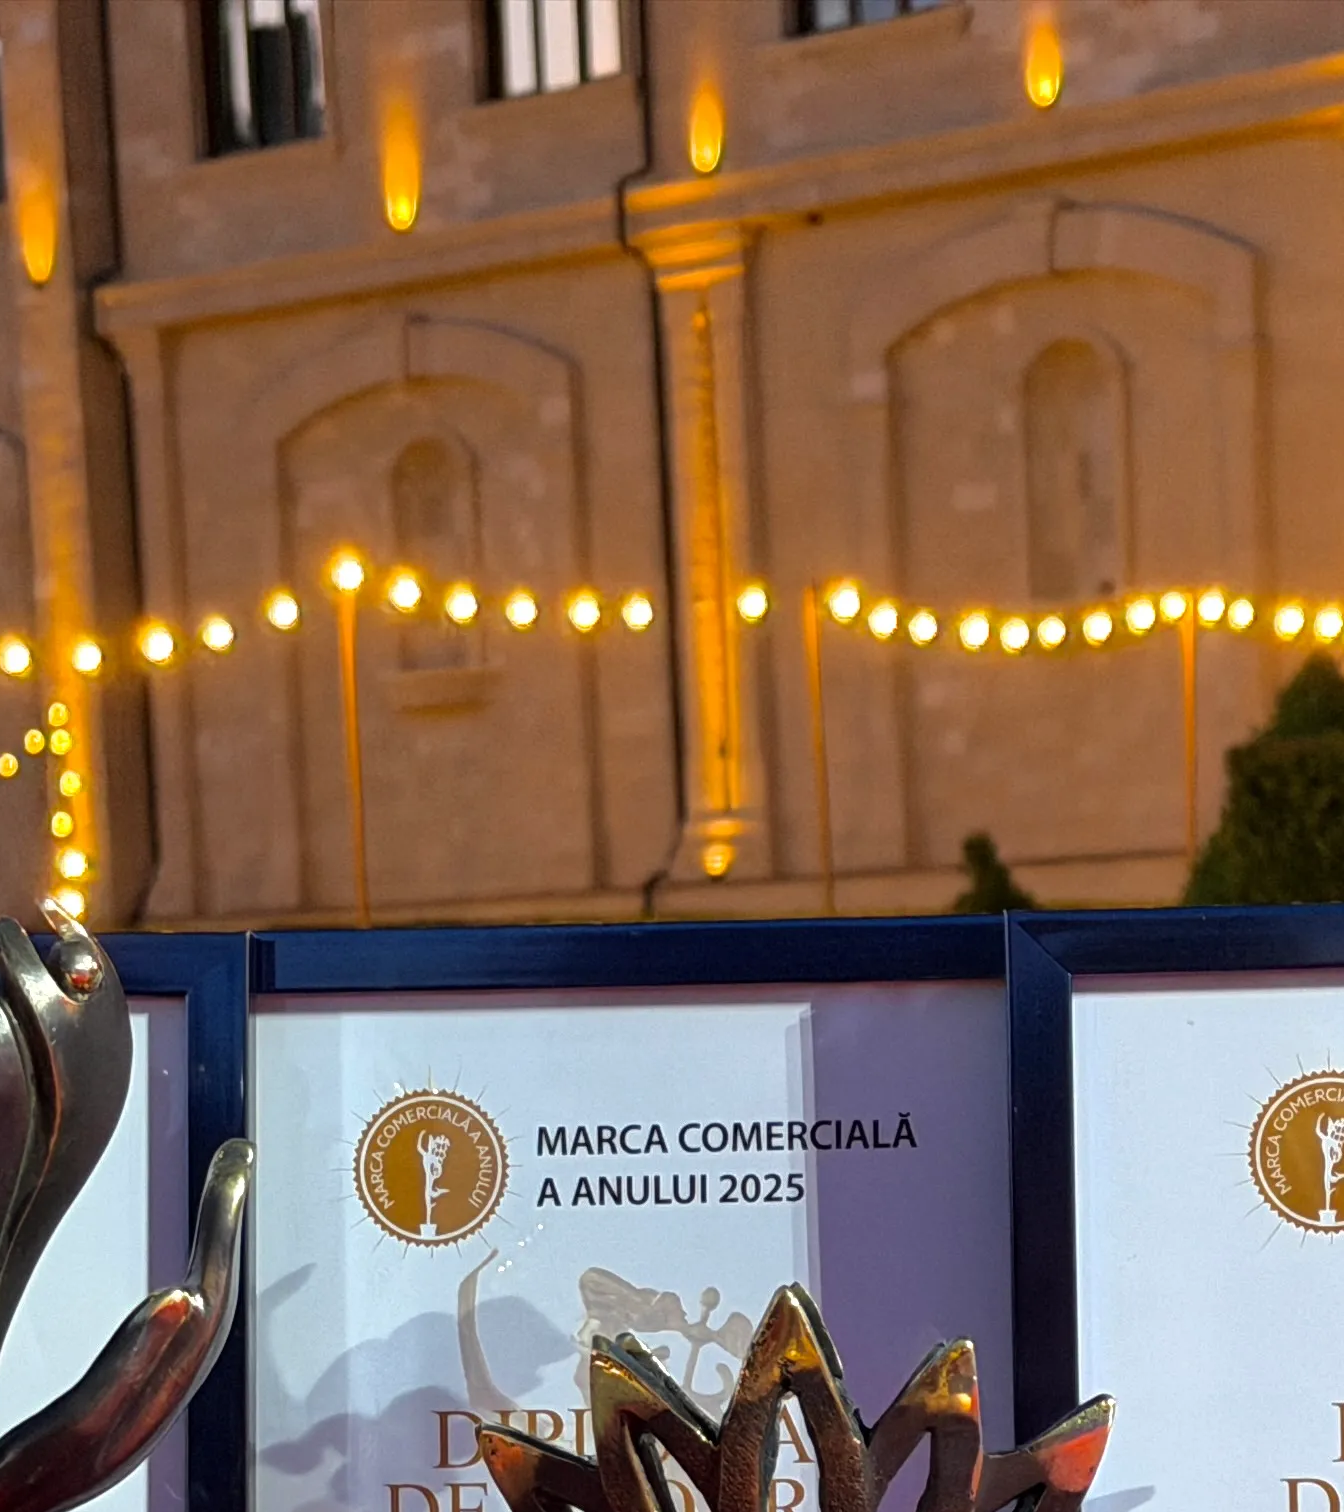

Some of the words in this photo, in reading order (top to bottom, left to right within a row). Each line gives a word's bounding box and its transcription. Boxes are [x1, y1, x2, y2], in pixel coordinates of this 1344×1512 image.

[377, 1106, 472, 1148] COMERCIALĂ
[536, 1123, 669, 1157] MARCA
[679, 1112, 918, 1156] COMERCIALĂ
[369, 1151, 394, 1211] MARCA
[468, 1141, 493, 1209] ANULUI
[536, 1176, 563, 1207] A
[571, 1173, 708, 1206] ANULUI
[720, 1172, 806, 1204] 2025
[1262, 1134, 1291, 1196] MARCA
